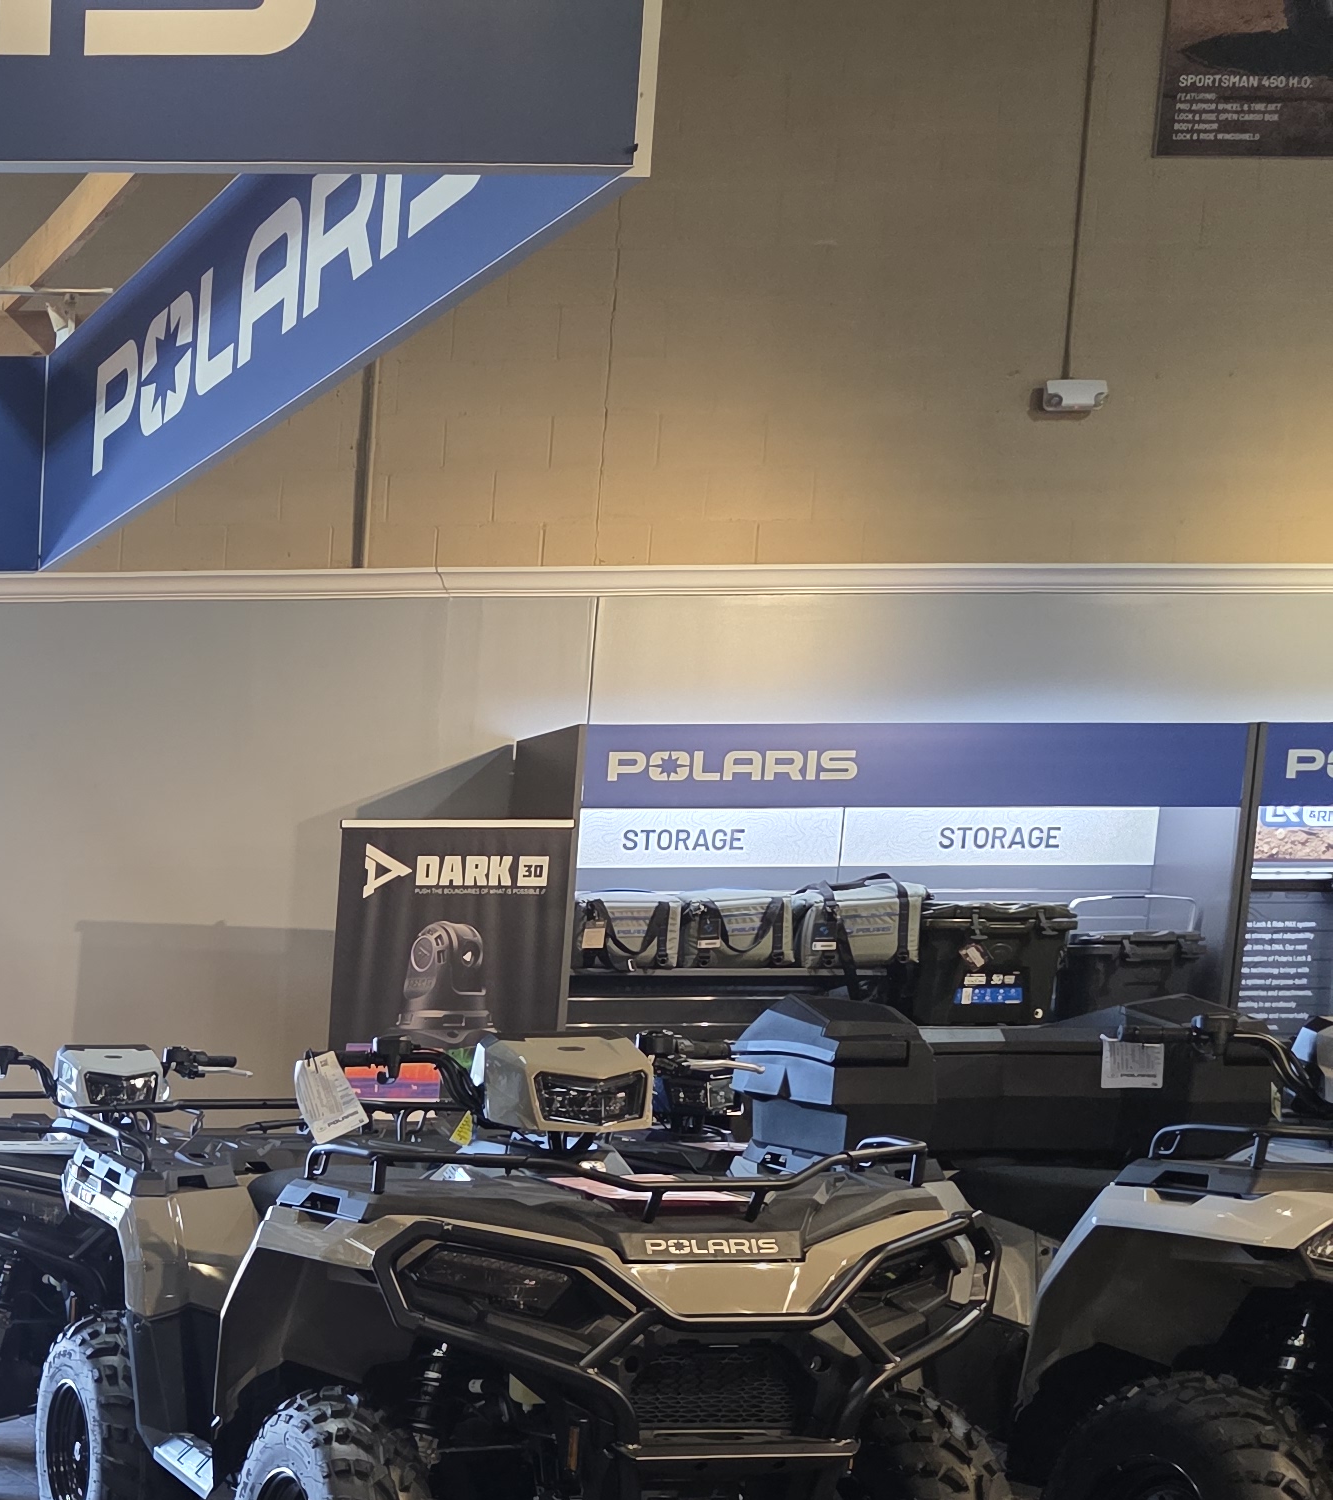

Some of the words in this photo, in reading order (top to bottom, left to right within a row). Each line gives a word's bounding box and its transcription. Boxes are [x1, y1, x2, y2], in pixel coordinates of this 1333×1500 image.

[1178, 75, 1258, 88] SPORTSMAN
[1261, 75, 1286, 88] 450
[607, 750, 858, 781] POLARIS
[622, 828, 745, 851] STORAGE
[938, 825, 1061, 851] STORAGE
[415, 855, 513, 886] DARK
[645, 1238, 779, 1254] POLARIS
